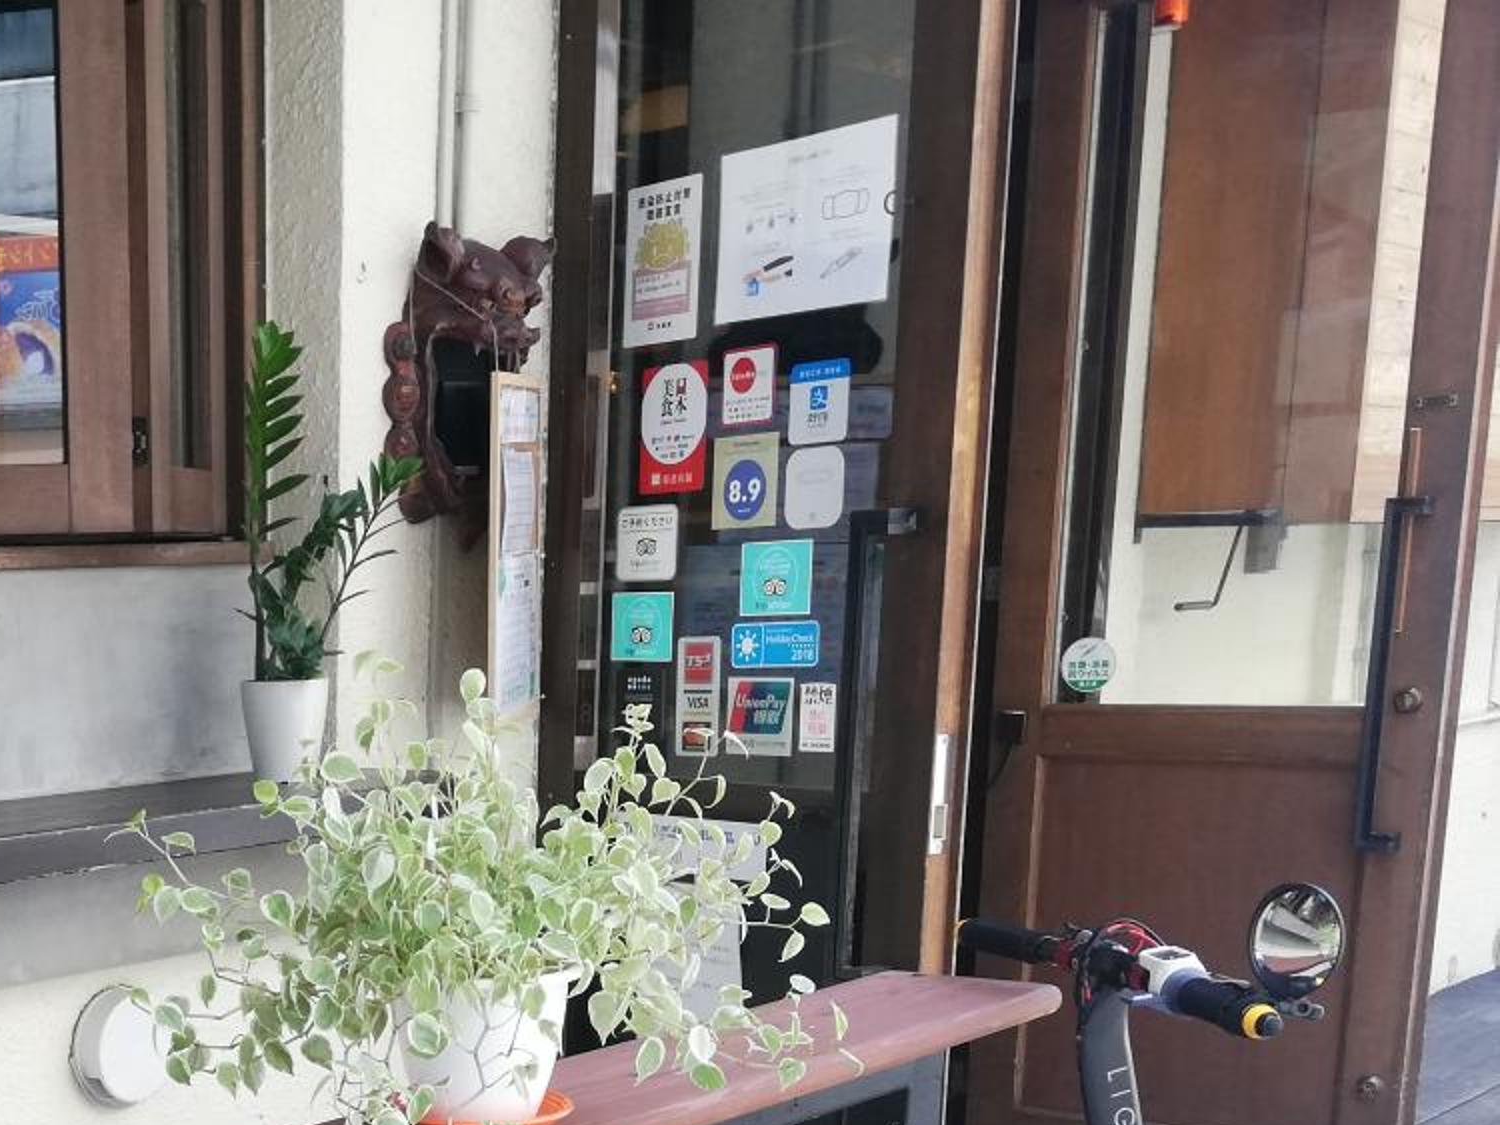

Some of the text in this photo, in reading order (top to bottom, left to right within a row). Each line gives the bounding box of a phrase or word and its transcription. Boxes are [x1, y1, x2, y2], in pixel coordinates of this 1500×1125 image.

[728, 477, 762, 504] 8.9
[687, 698, 709, 709] VISA
[735, 692, 788, 711] UnionPay
